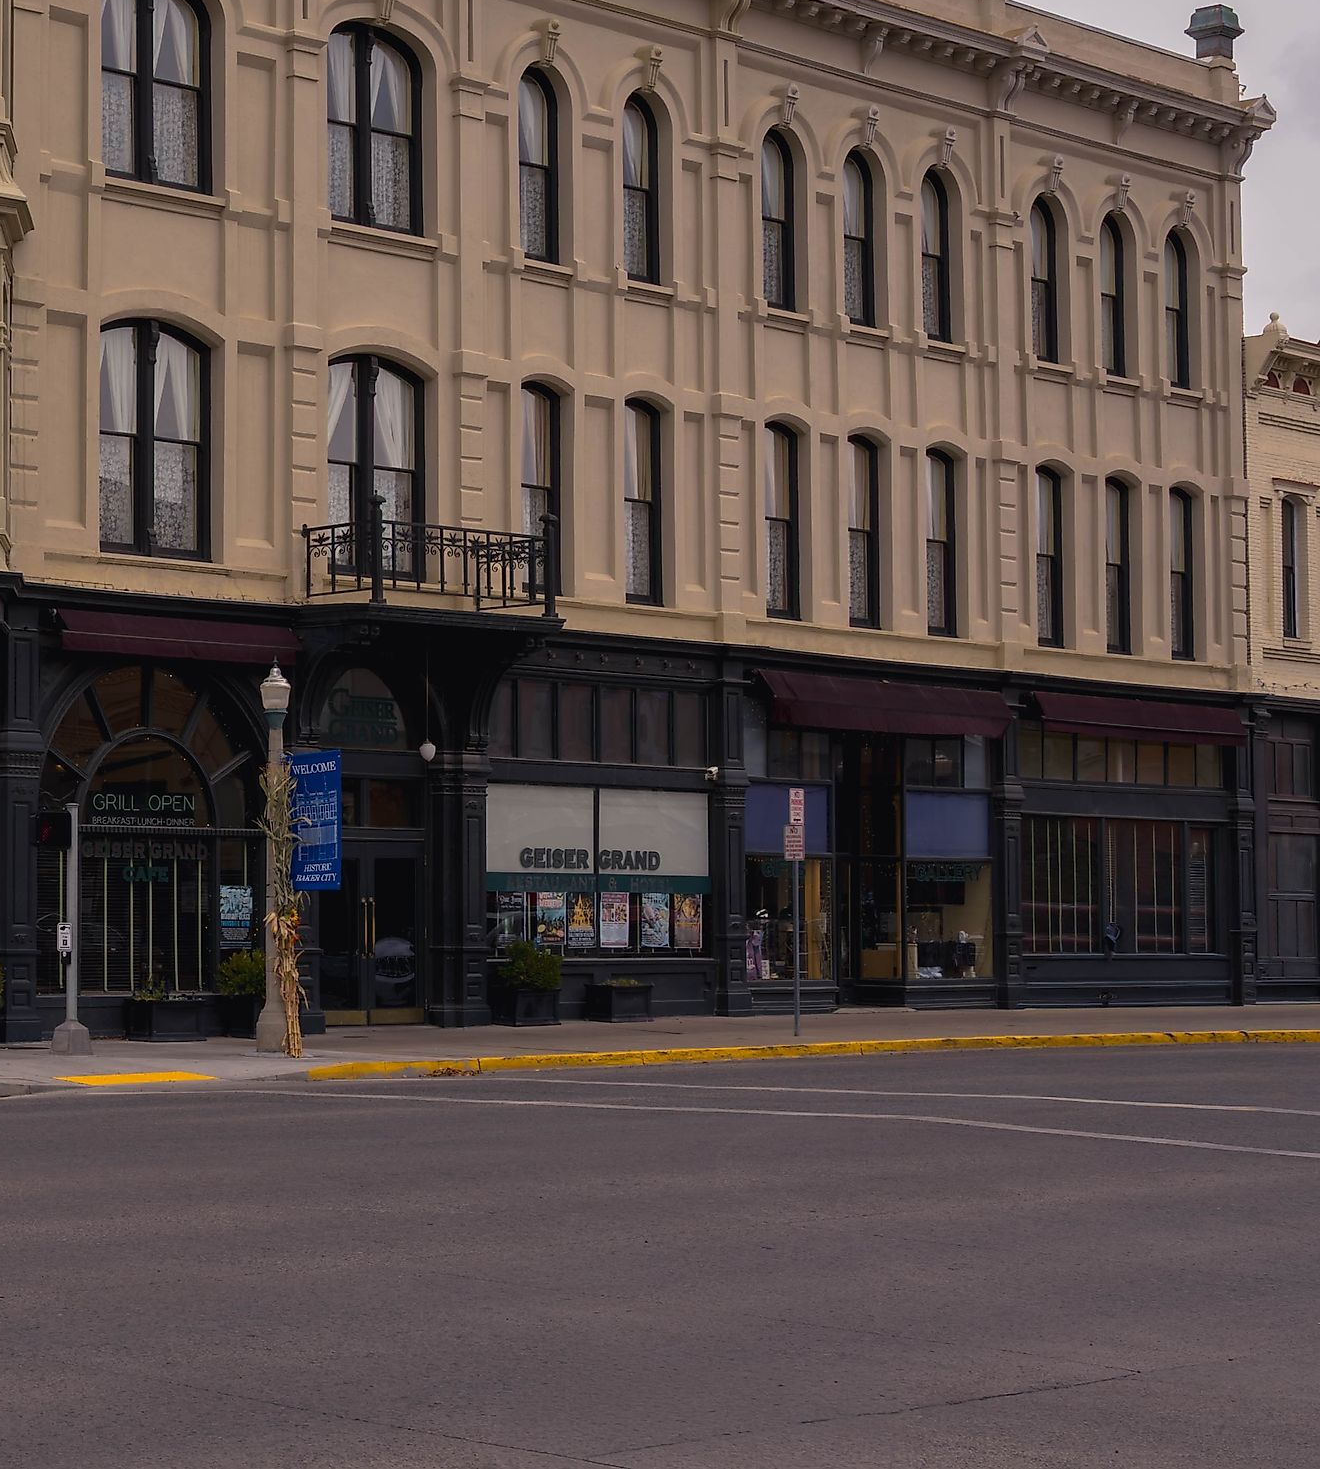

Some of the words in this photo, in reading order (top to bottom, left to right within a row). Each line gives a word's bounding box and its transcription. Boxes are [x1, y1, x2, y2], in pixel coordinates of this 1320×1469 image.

[329, 719, 398, 743] GRAND
[292, 760, 337, 775] WELCOME
[92, 793, 140, 811] GRILL
[148, 794, 196, 812] OPEN
[151, 842, 208, 860] GRAND
[519, 847, 590, 869] GEISER
[598, 849, 661, 871] GRAND
[304, 862, 333, 873] HISTORIC
[295, 874, 320, 882] BAKER
[321, 872, 337, 882] CITY
